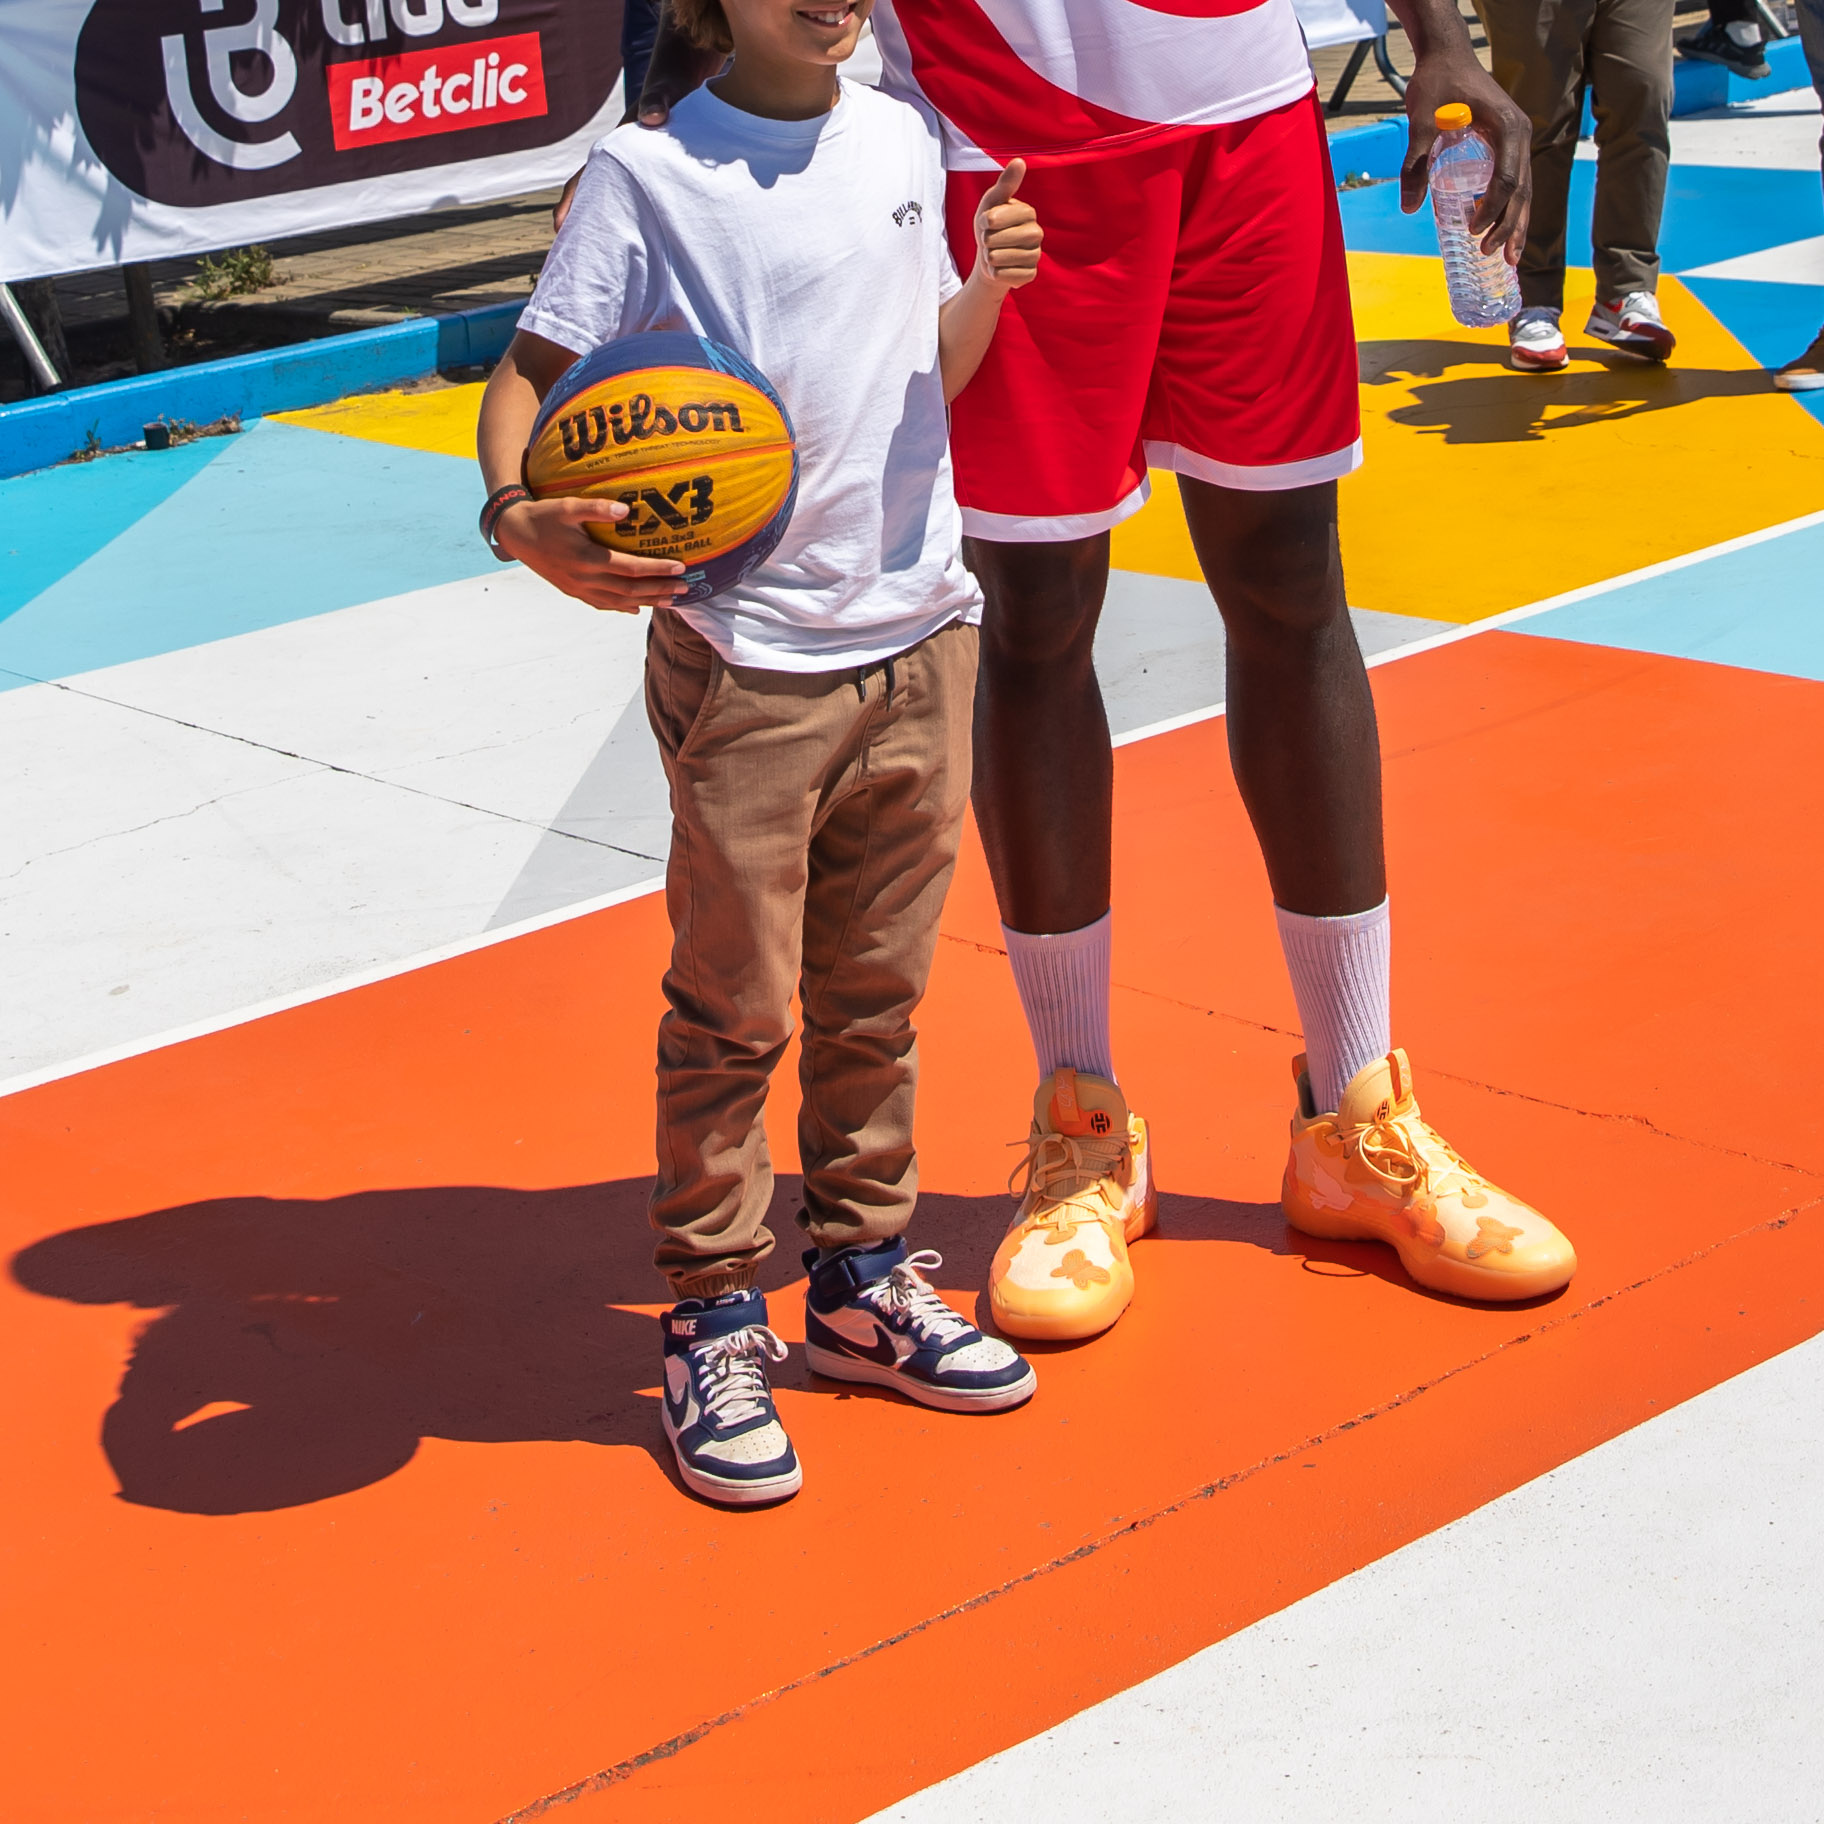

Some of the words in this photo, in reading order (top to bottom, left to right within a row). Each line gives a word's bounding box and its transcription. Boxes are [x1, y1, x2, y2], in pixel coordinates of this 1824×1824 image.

[348, 52, 529, 132] Betclic
[558, 393, 745, 462] Wilson
[585, 456, 610, 470] WAVE
[639, 536, 668, 549] FIBA
[684, 537, 713, 552] BALL
[671, 1319, 697, 1336] NIKE
